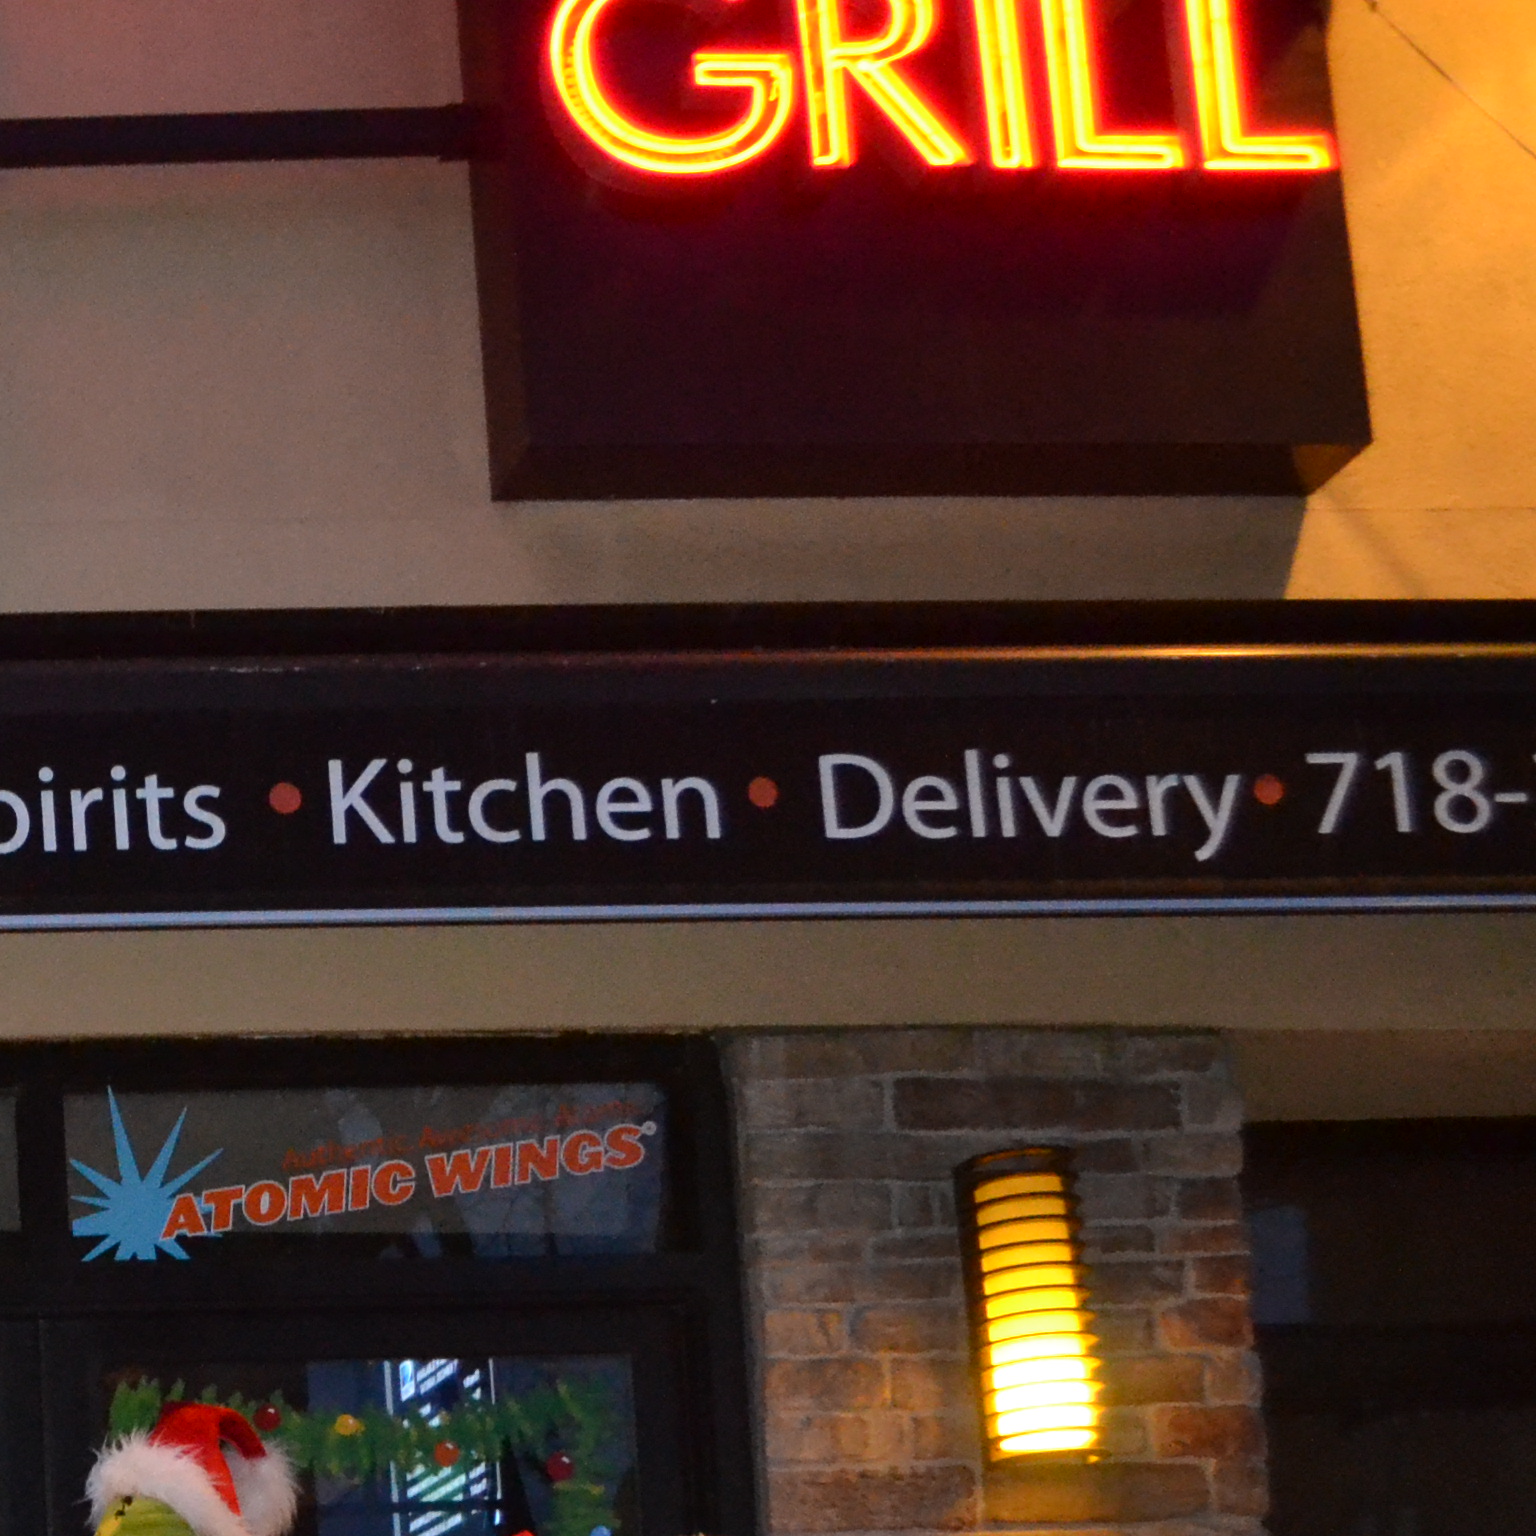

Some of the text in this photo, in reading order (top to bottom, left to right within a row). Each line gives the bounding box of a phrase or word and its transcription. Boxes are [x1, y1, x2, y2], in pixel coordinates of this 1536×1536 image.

[548, 0, 1338, 173] GRILL
[328, 752, 723, 847] Kitchen
[816, 748, 1242, 863] Delivery
[1303, 749, 1536, 834] 718-
[159, 1160, 416, 1241] ATOMIC
